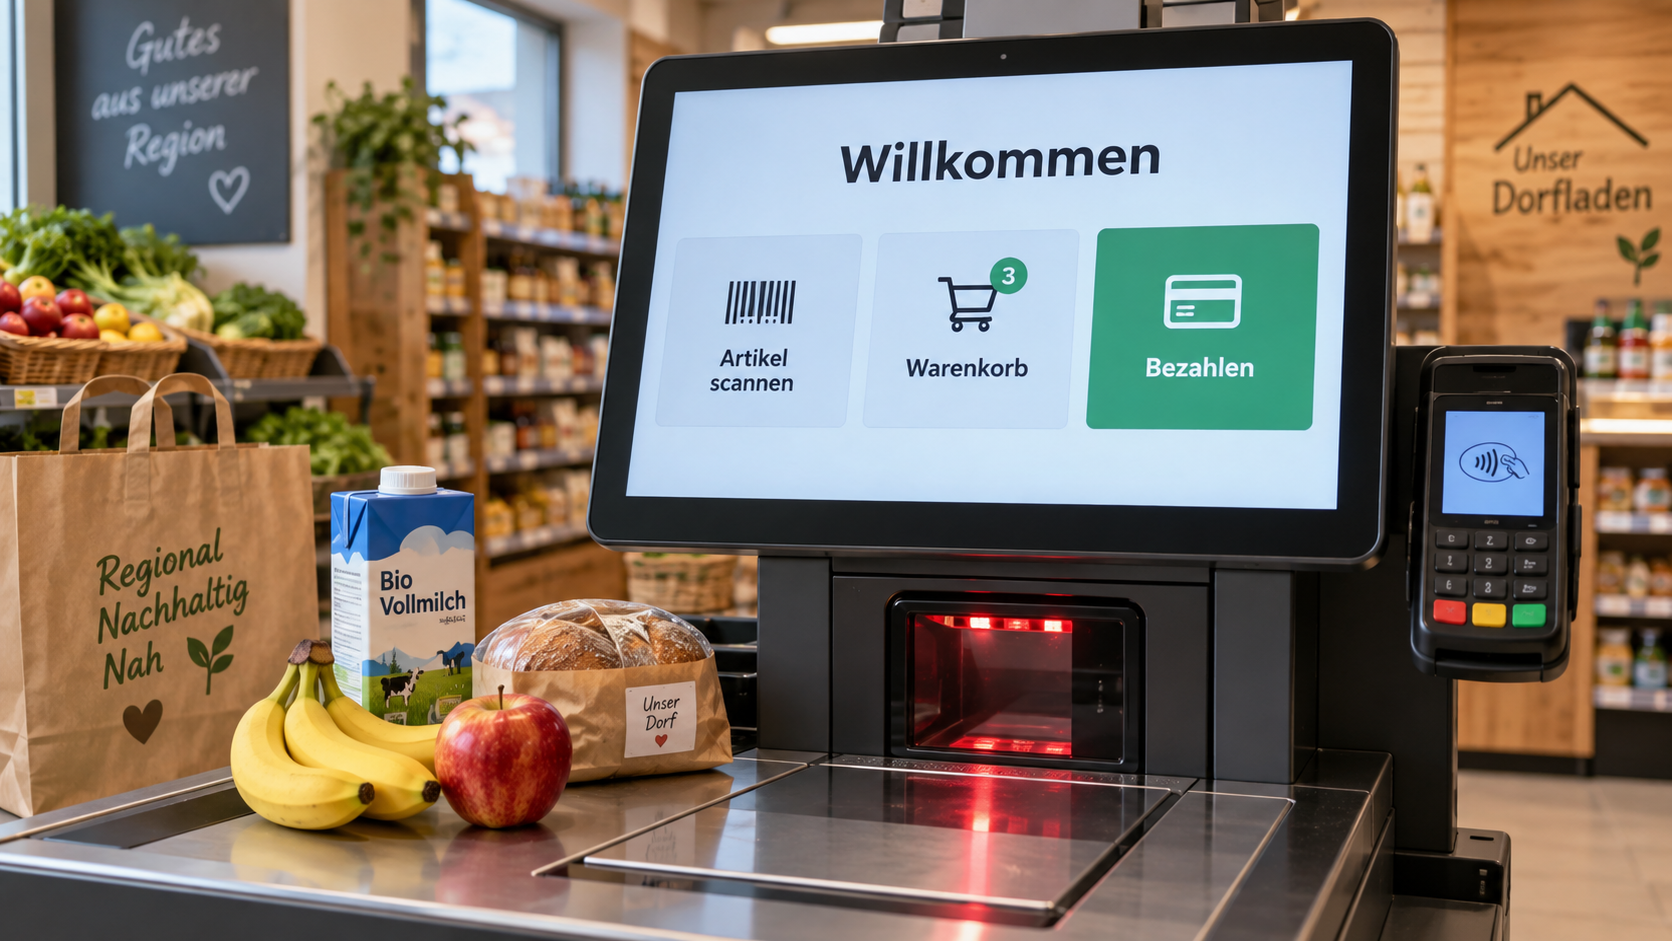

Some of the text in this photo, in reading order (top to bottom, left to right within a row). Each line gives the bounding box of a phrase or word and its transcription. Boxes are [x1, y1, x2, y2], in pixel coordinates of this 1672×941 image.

[126, 15, 222, 76] Gutes
[91, 66, 259, 121] aus unserer
[124, 120, 227, 177] Region
[841, 139, 1161, 184] Willkommen
[1514, 144, 1583, 172] Unser
[1493, 177, 1652, 215] Dorfladen
[1002, 266, 1016, 285] 3
[720, 348, 788, 368] Artikel
[906, 357, 1029, 379] Warenkorb
[1145, 356, 1254, 378] Bezahlen
[709, 376, 794, 393] scannen
[96, 527, 223, 597] Regional
[380, 569, 413, 591] Bio
[98, 574, 249, 644] Nachhaltig
[380, 590, 466, 615] Vollmilch
[103, 640, 164, 690] Nah
[643, 695, 680, 712] Unser
[645, 711, 678, 731] Dorf
